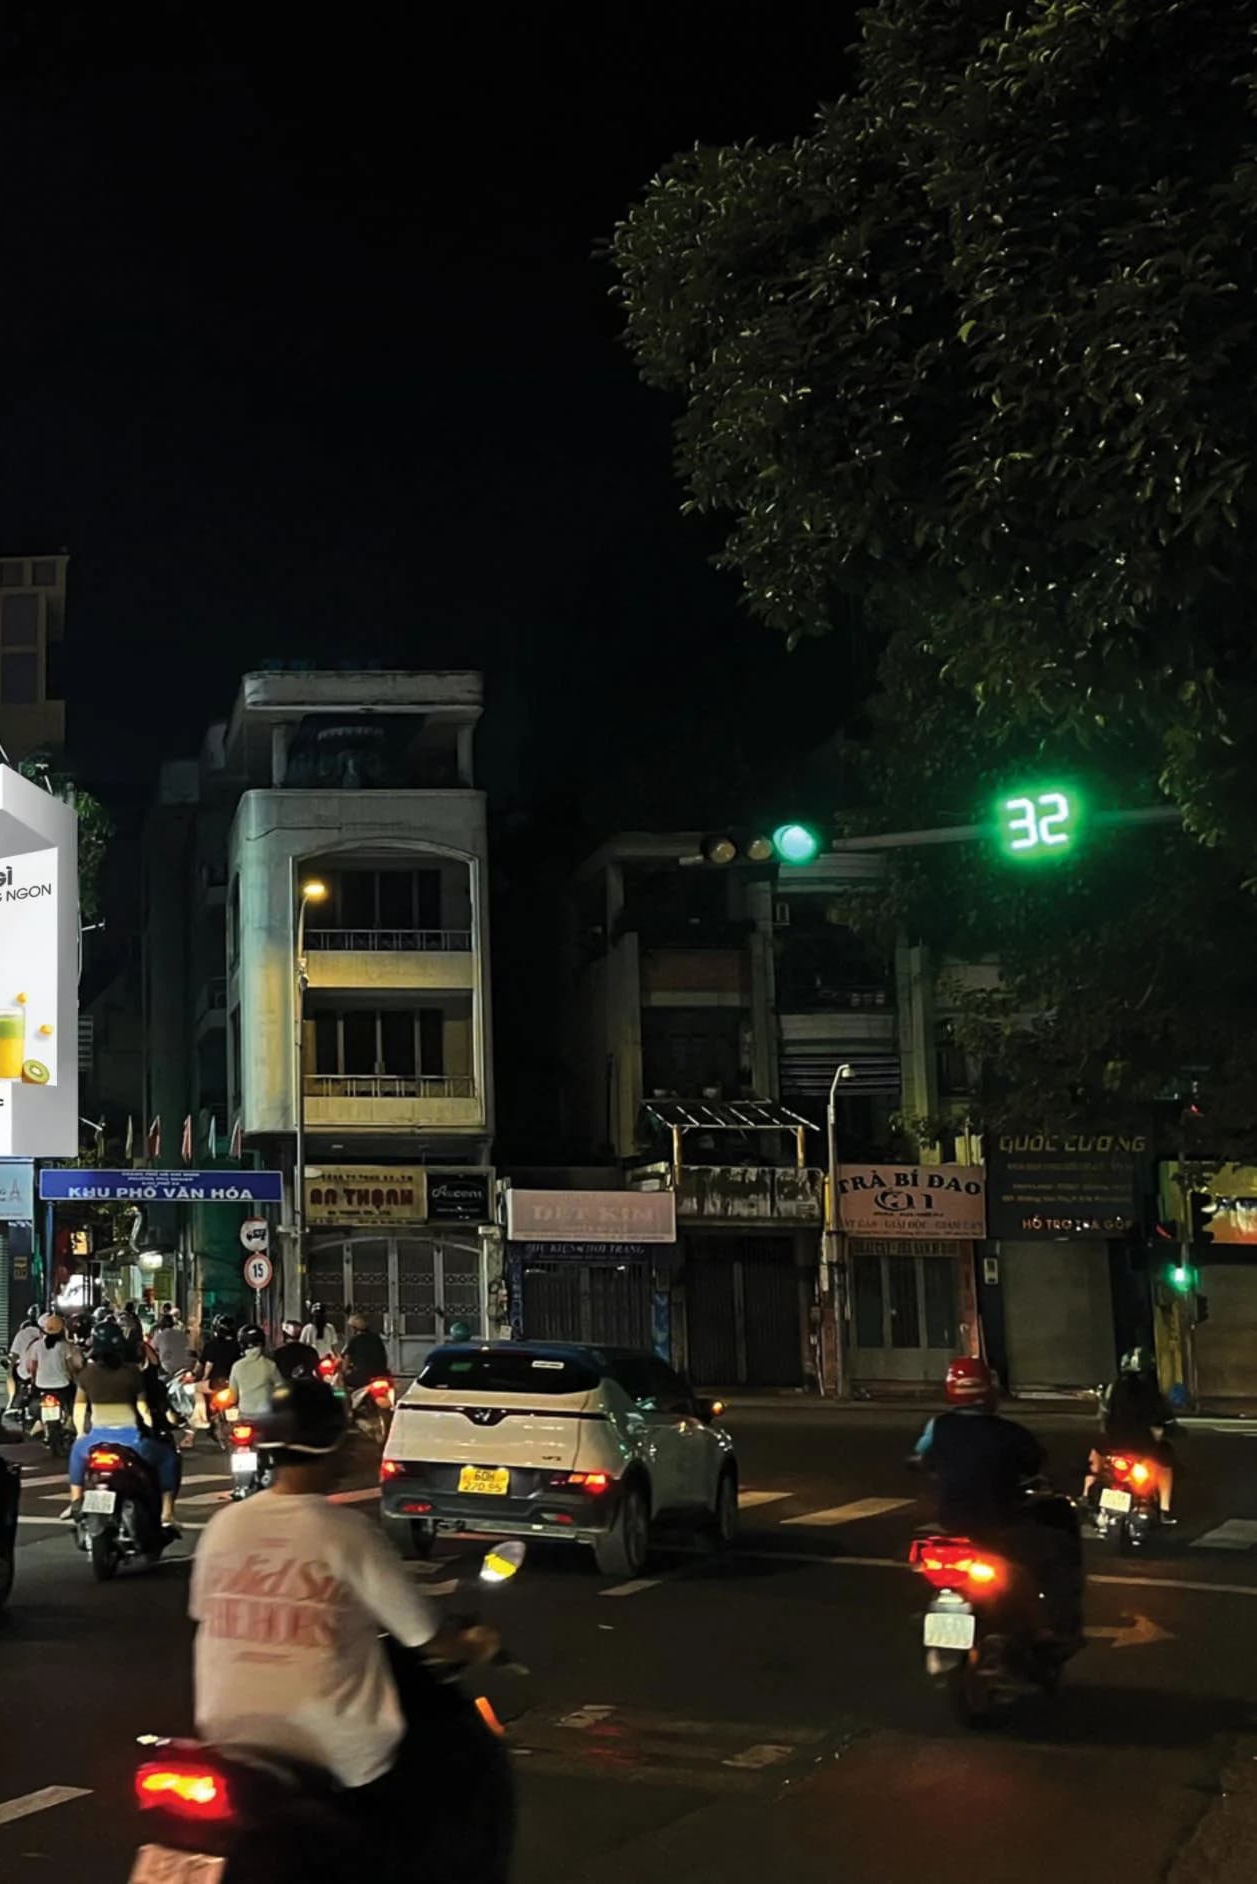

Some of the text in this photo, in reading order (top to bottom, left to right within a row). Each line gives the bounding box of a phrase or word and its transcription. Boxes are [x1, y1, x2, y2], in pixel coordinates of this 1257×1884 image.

[1005, 793, 1069, 850] 32
[6, 883, 52, 902] NGON
[68, 1186, 110, 1199] KHU
[211, 1186, 253, 1199] HÓA
[252, 1263, 264, 1278] 15
